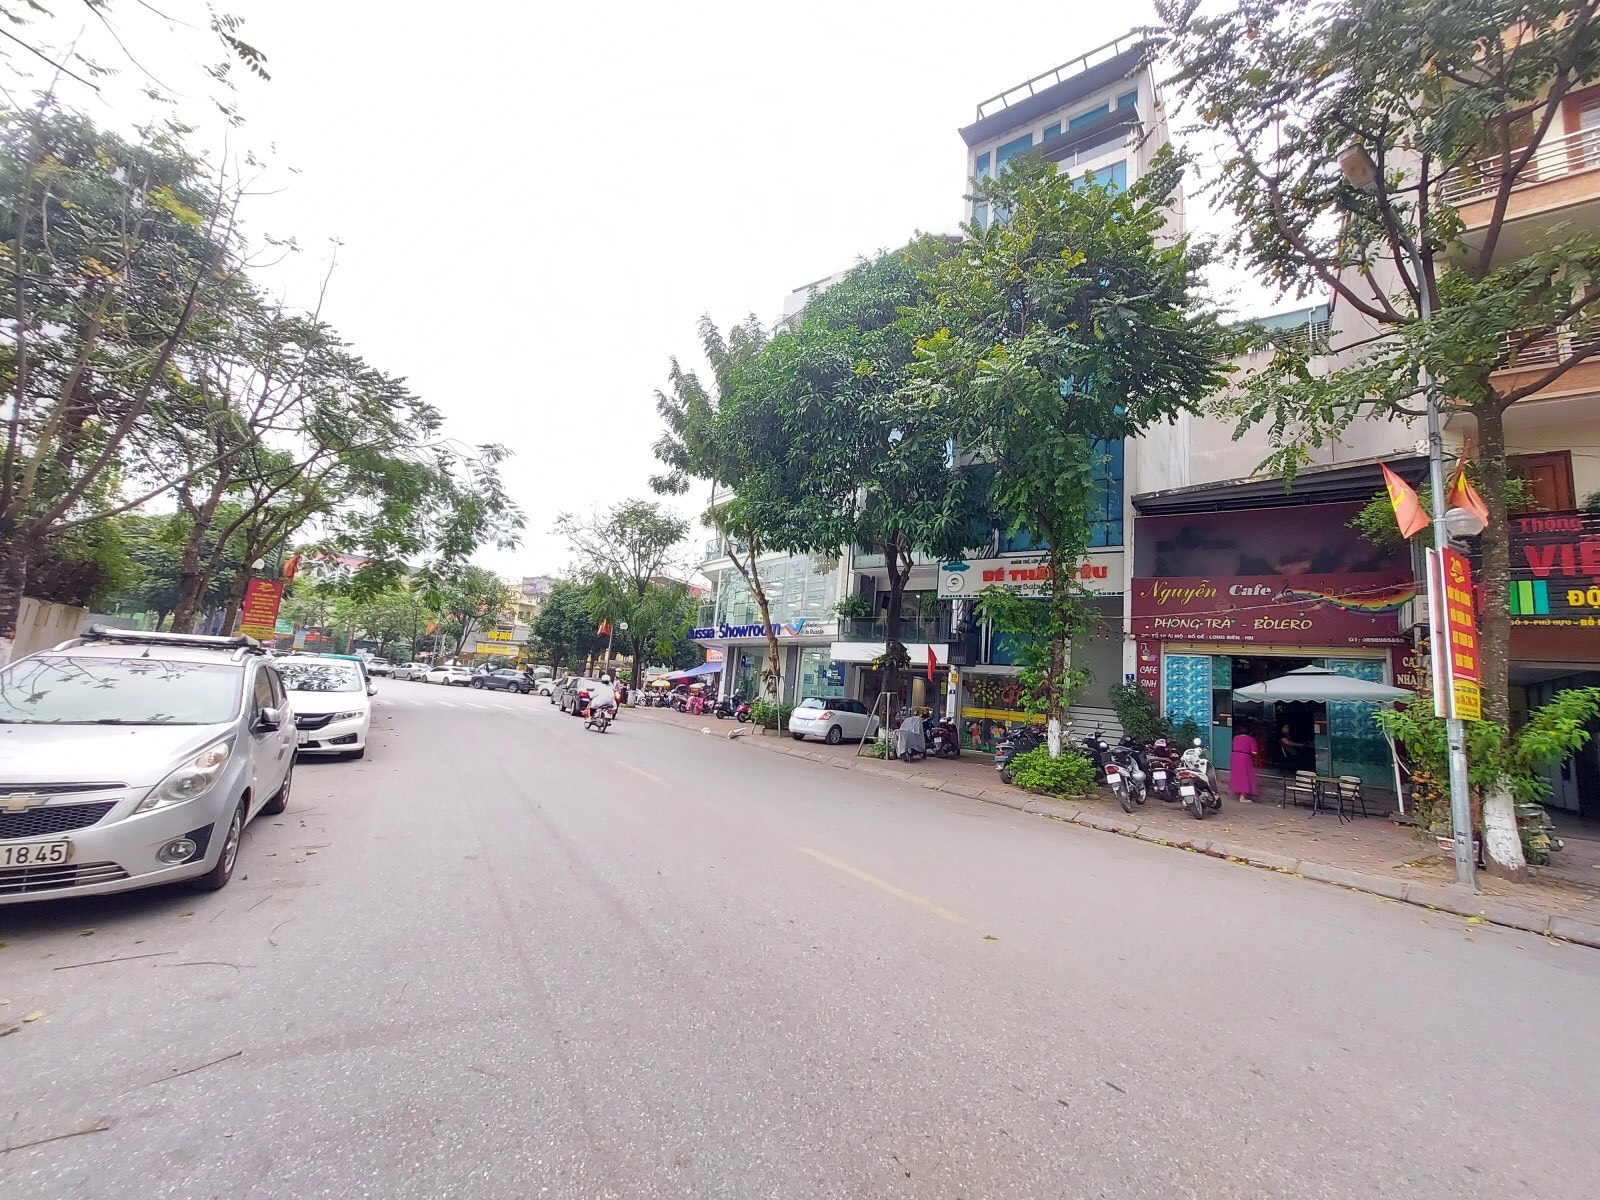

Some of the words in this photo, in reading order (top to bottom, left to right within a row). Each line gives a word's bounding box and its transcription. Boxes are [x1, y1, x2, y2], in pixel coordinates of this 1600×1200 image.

[1140, 580, 1217, 605] Nguyễn
[1229, 584, 1271, 596] Cafe
[1253, 619, 1313, 631] BOLERO
[1140, 665, 1158, 674] CAFE
[1140, 679, 1157, 688] SINH
